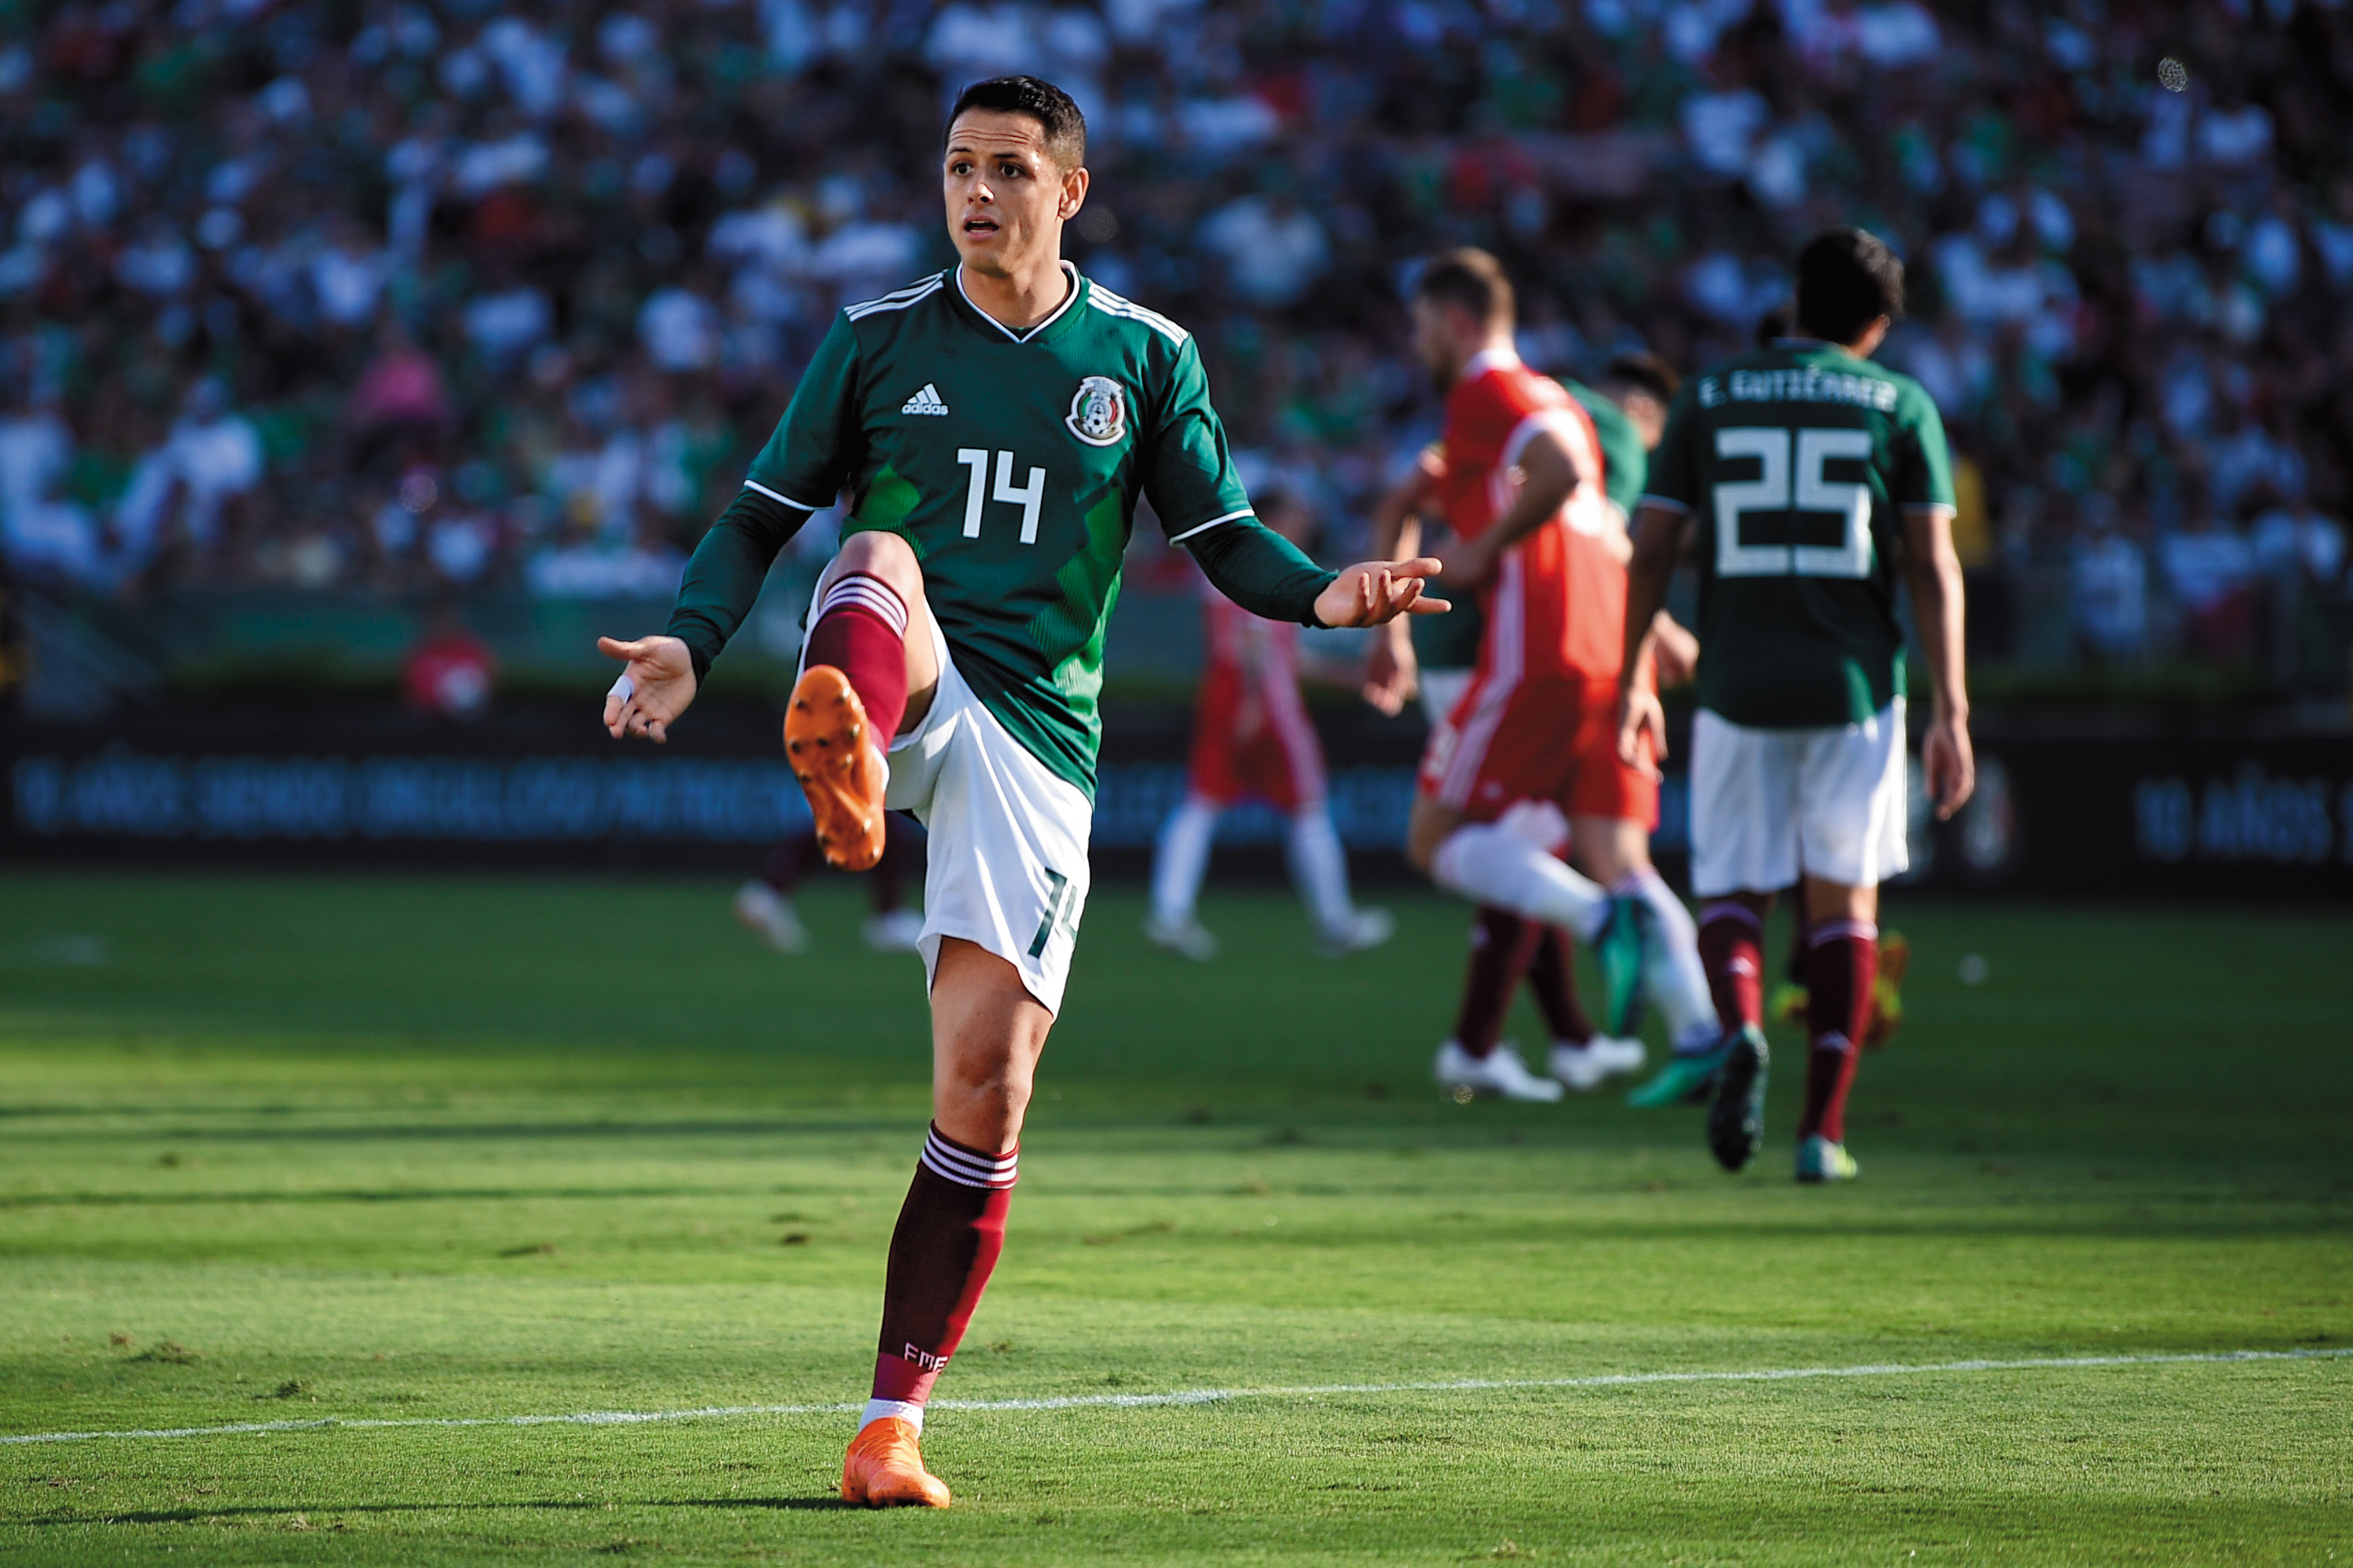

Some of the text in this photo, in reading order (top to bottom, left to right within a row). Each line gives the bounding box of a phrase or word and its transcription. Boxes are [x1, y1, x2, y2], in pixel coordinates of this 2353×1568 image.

[901, 401, 949, 417] adidas
[957, 447, 1046, 545] 14
[1713, 427, 1873, 578] 25
